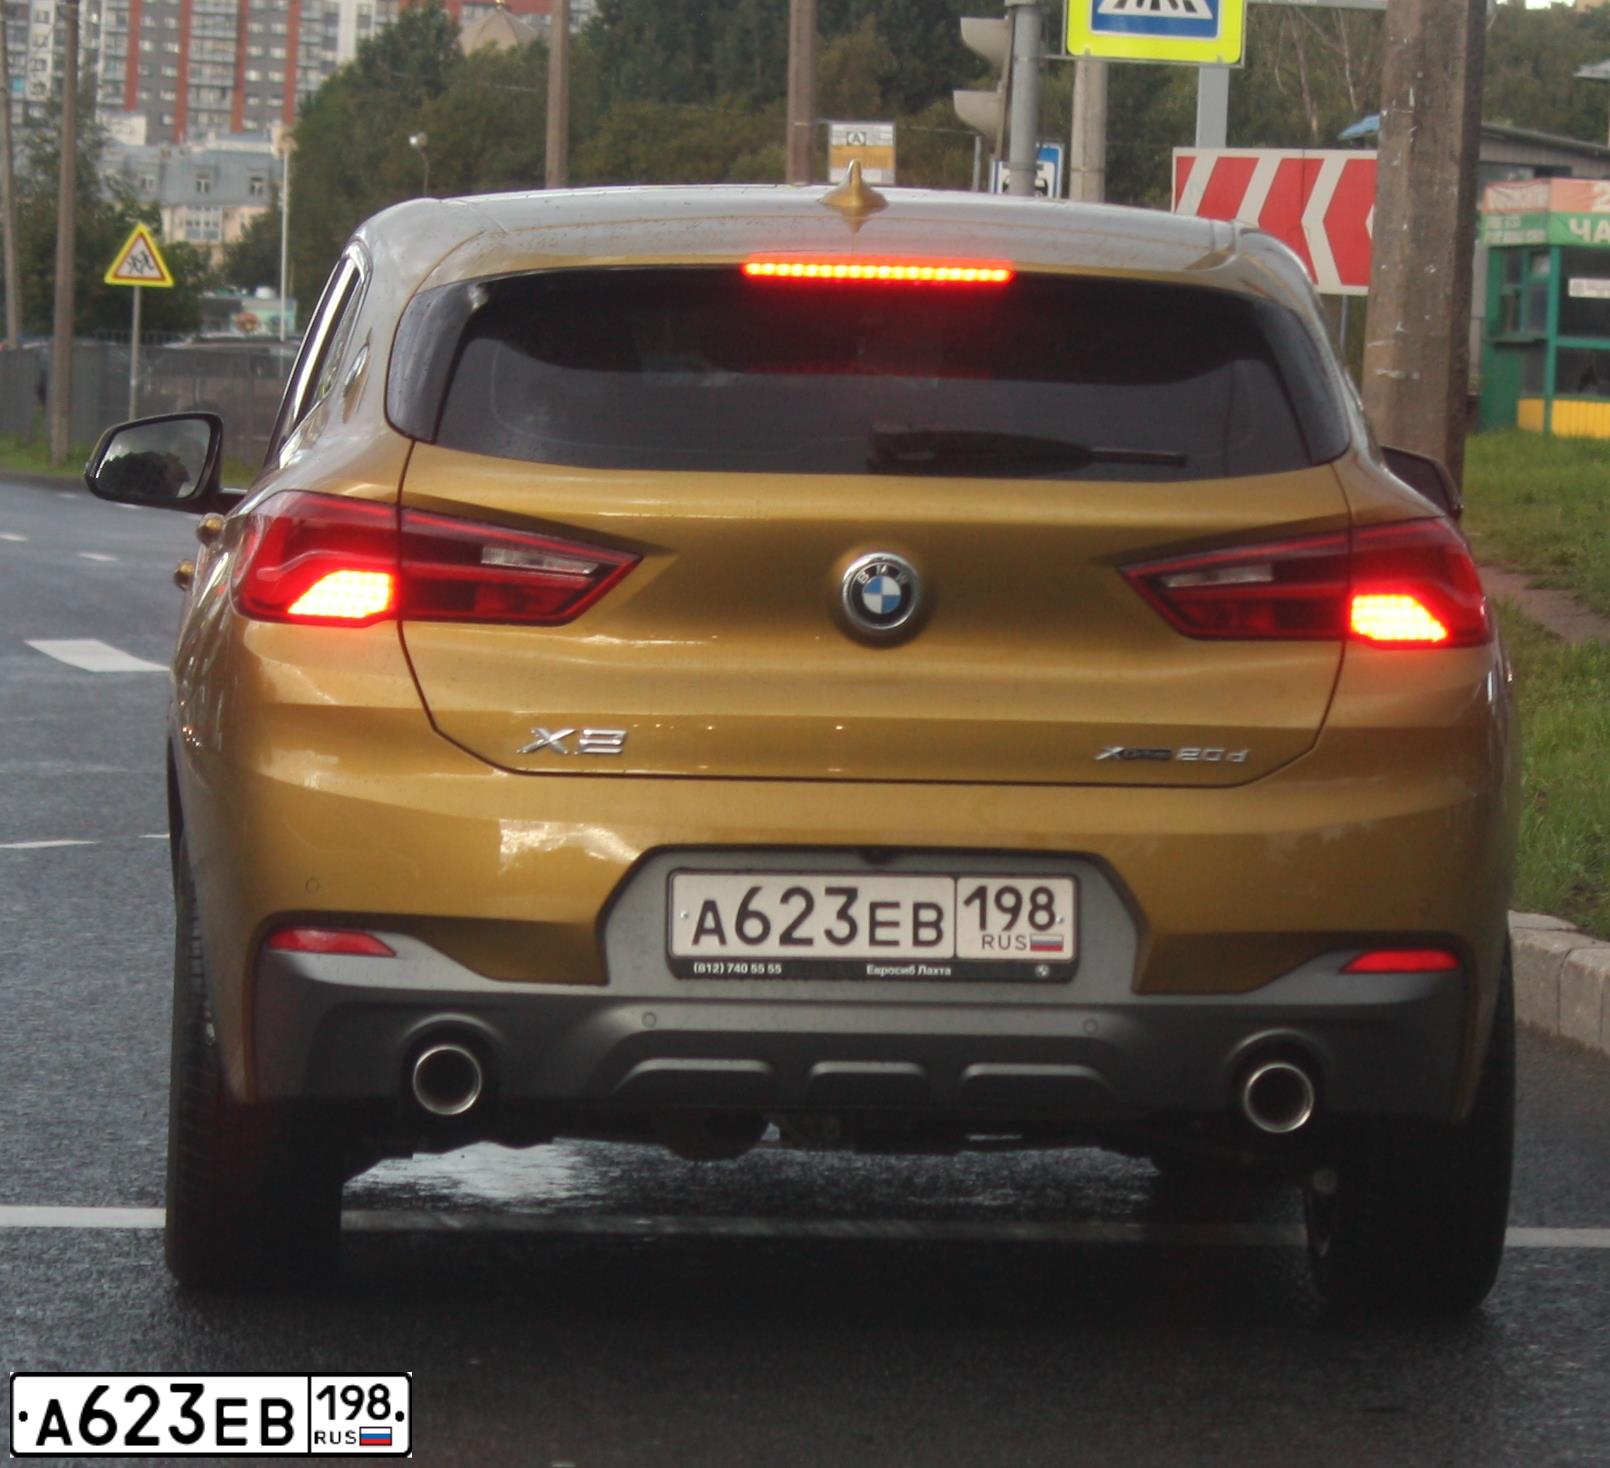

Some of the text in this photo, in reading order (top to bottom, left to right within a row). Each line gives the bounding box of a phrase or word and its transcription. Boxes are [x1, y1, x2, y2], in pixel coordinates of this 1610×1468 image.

[963, 885, 1056, 932] 198
[981, 935, 1027, 951] RUS
[726, 963, 749, 974] 740
